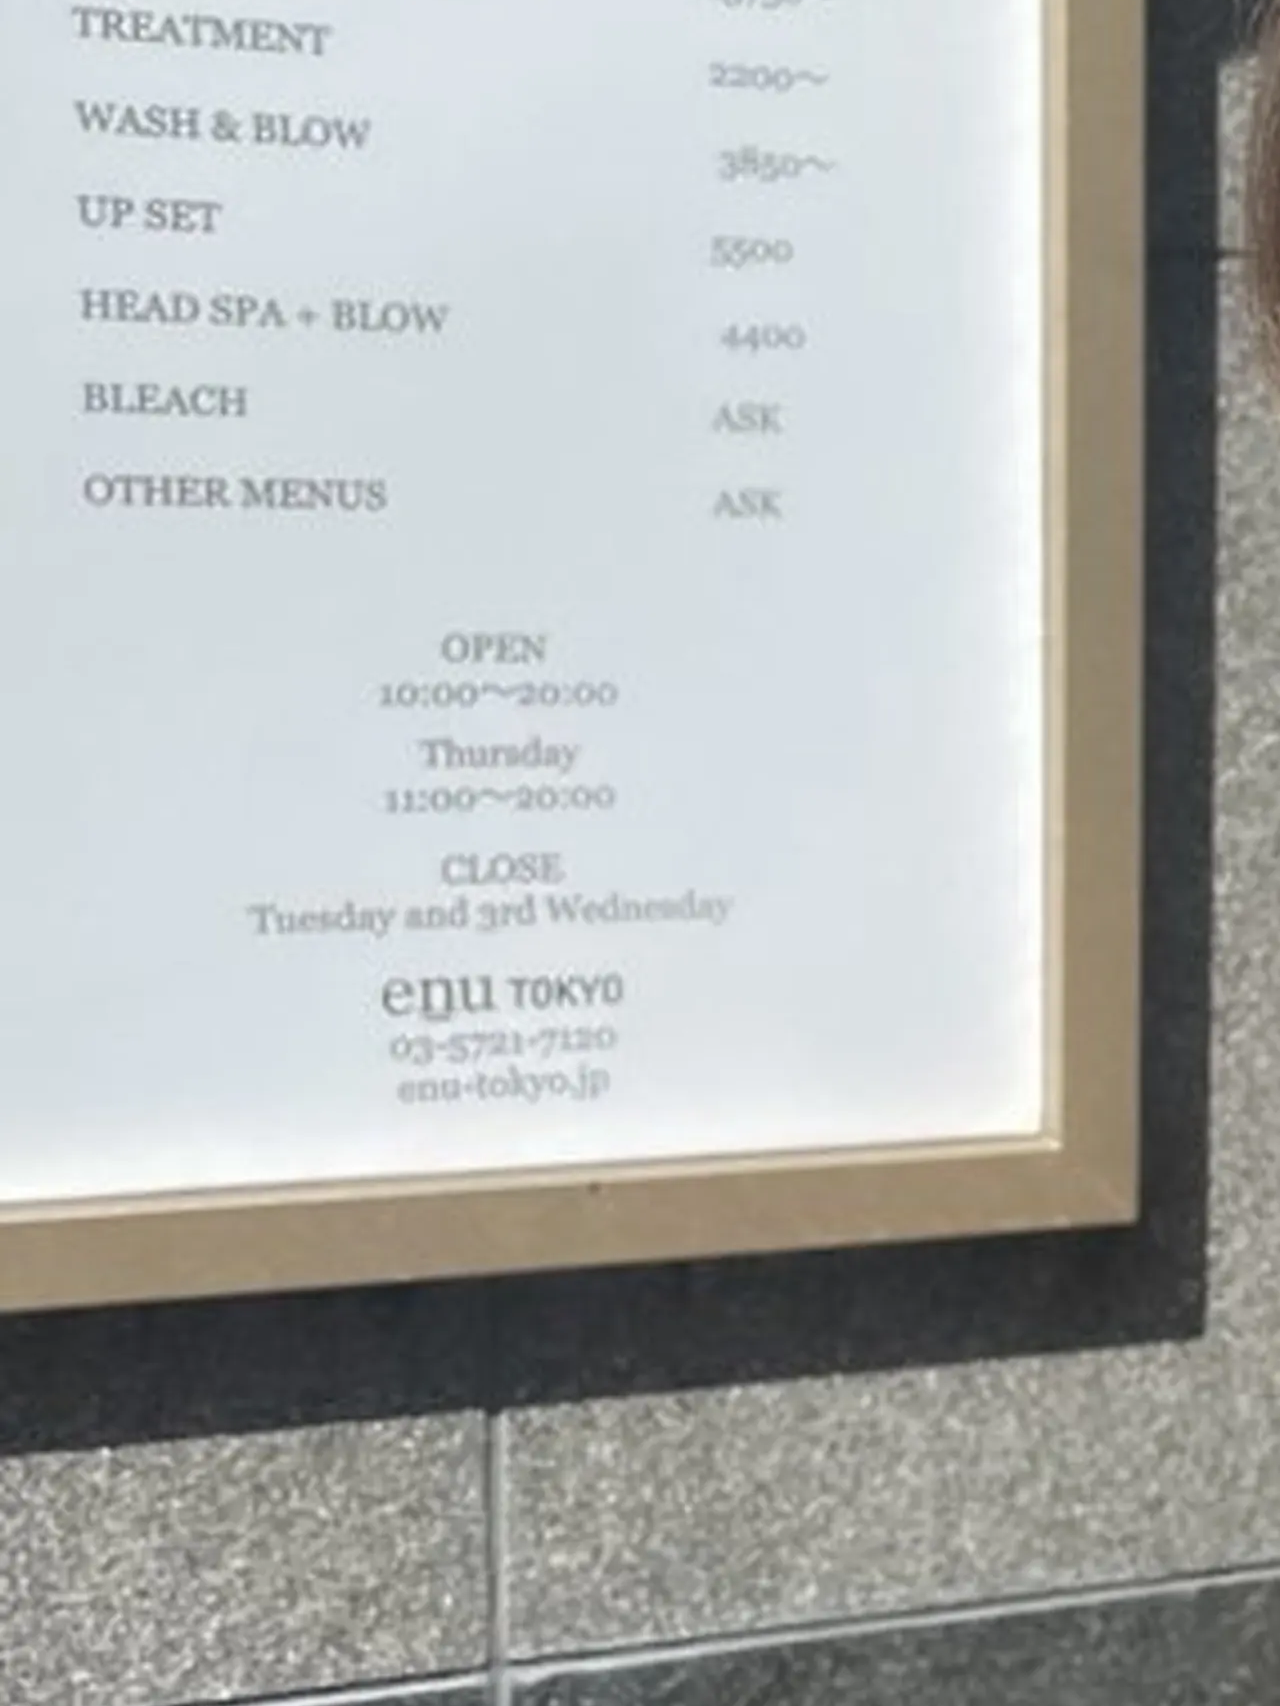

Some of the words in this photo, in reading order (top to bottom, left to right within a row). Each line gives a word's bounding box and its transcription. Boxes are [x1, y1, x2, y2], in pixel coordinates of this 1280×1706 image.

[71, 4, 332, 58] TREATMENT
[73, 100, 204, 143] WASH
[208, 108, 245, 145] &
[249, 111, 372, 151] BLOW
[75, 194, 138, 231] UP
[142, 197, 224, 235] SET
[711, 236, 794, 270] 5500
[79, 287, 203, 327] HEAD
[207, 292, 290, 330] SPA
[295, 306, 320, 328] +
[330, 299, 450, 335] BLOW
[720, 323, 806, 353] 4400
[82, 381, 248, 419] BLEACH
[713, 402, 781, 435] ASK
[83, 472, 233, 510] OTHER
[237, 476, 389, 513] MENUS
[713, 488, 781, 519] ASK
[441, 631, 547, 665] OPEN
[418, 735, 579, 775] Thursday
[440, 852, 565, 888] CLOSE
[246, 900, 396, 940] Tuesday
[404, 898, 469, 931] and
[473, 895, 537, 933] 3rd
[543, 890, 731, 926] Wednesday
[381, 973, 496, 1022] enu
[509, 972, 625, 1008] TOKYO
[389, 1025, 618, 1066] 03-5721-7120
[396, 1064, 611, 1105] enu-tokyo.jp
